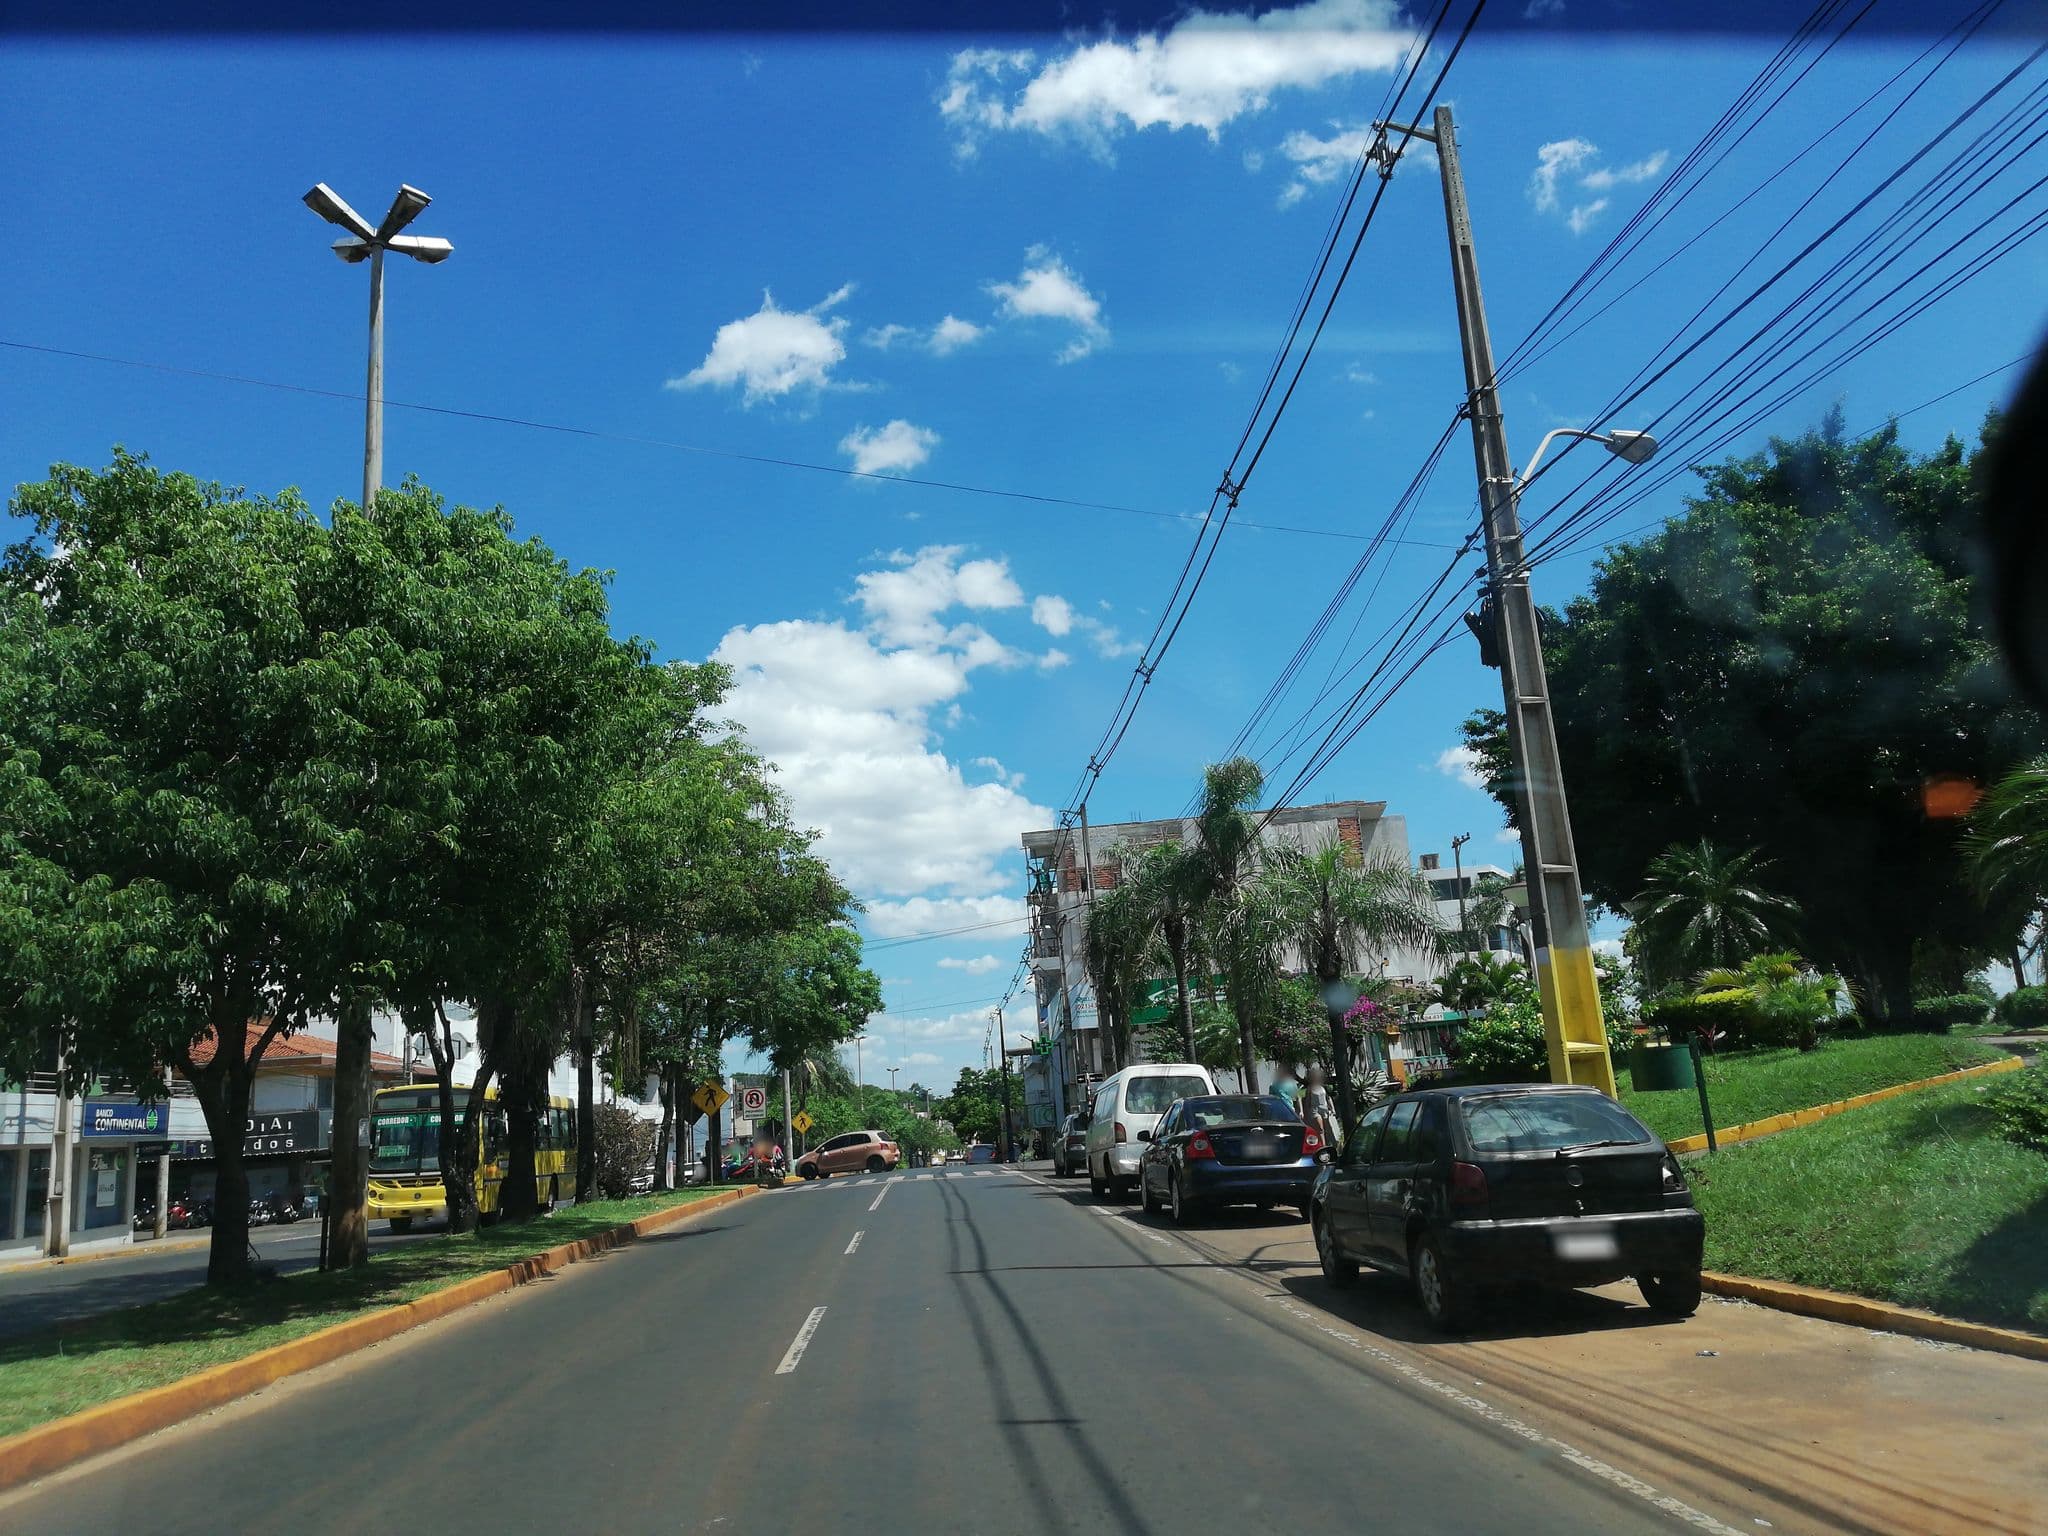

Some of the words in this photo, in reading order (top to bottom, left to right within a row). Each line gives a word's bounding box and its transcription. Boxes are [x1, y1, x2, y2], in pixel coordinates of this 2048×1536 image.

[95, 1108, 114, 1118] BANCO
[95, 1118, 147, 1131] CONTINENTAL
[377, 1117, 409, 1126] CORREDOR
